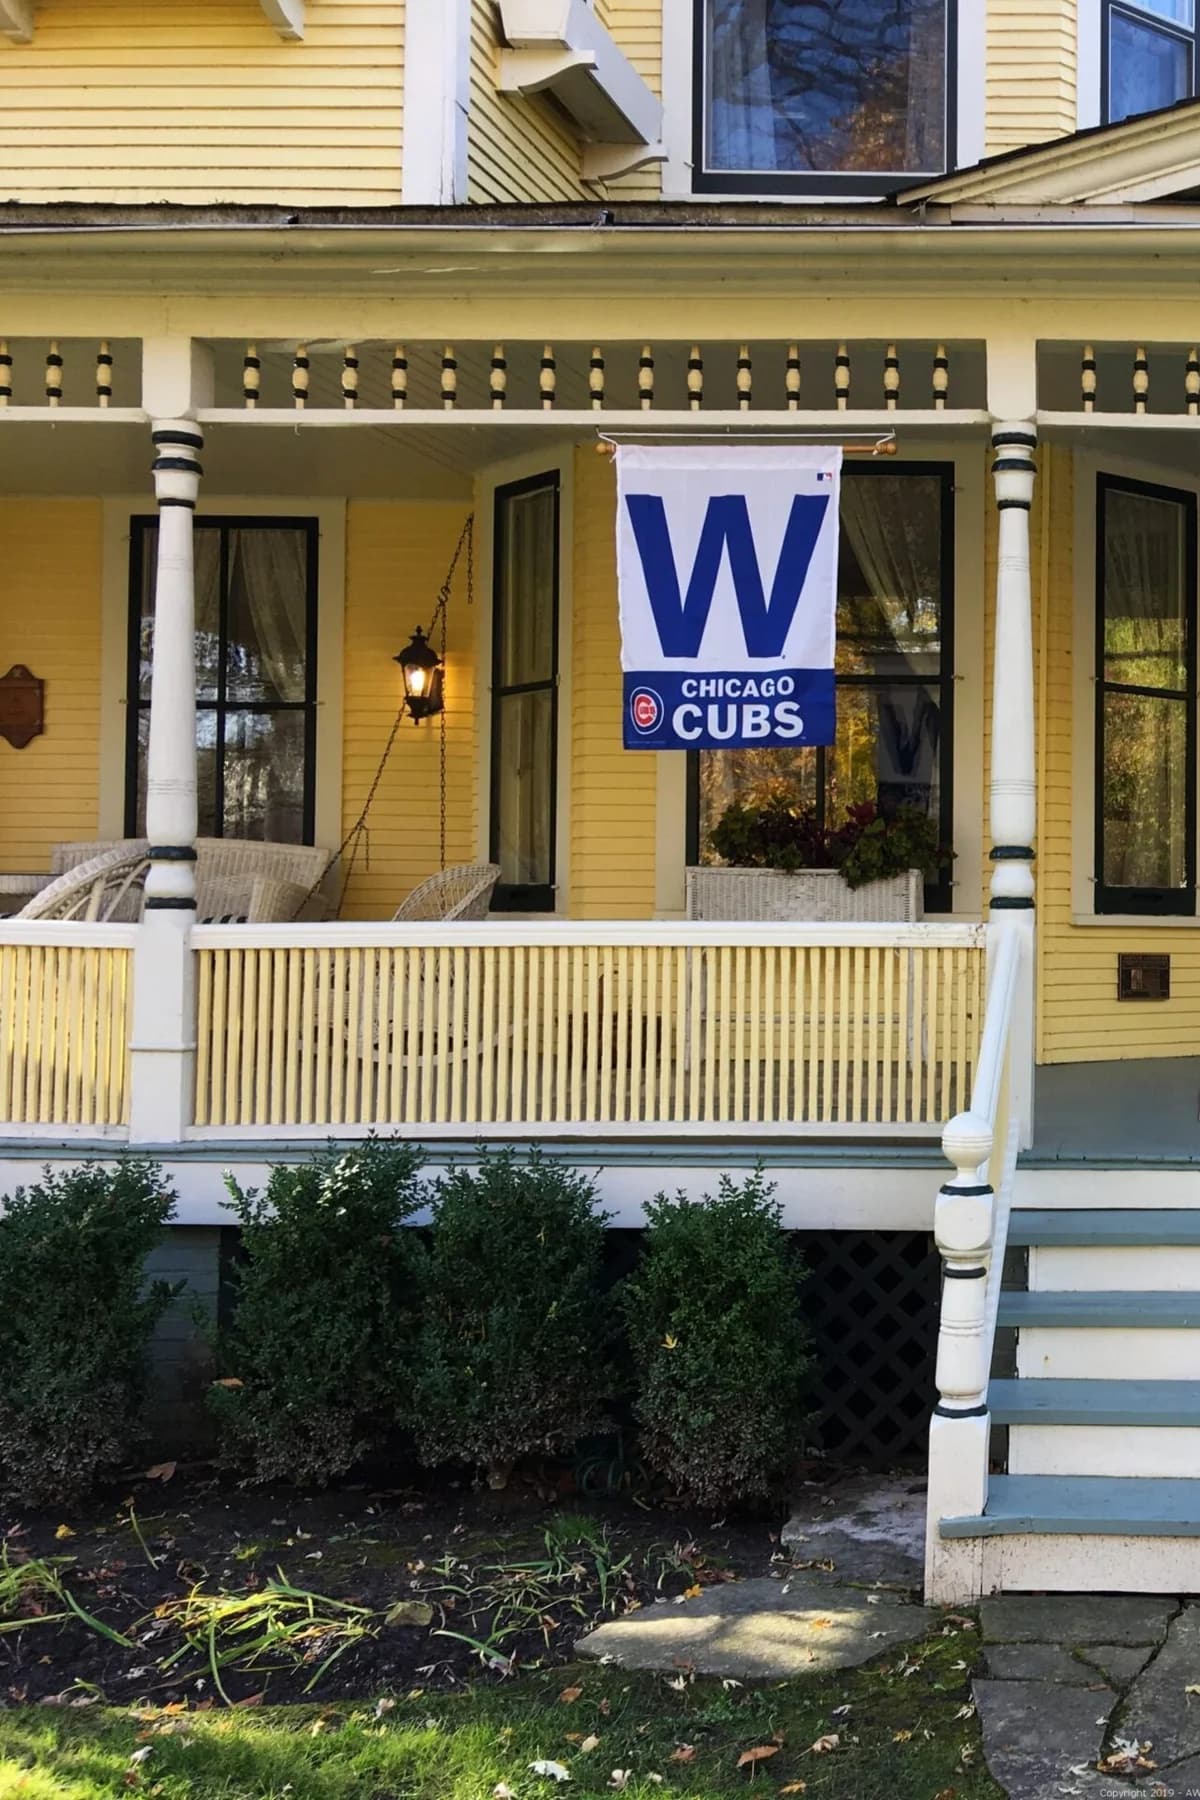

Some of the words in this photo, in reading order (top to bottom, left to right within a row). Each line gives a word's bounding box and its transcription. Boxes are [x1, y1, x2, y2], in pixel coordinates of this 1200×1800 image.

[625, 494, 830, 658] W
[681, 676, 795, 698] CHICAGO
[672, 701, 804, 740] CUBS
